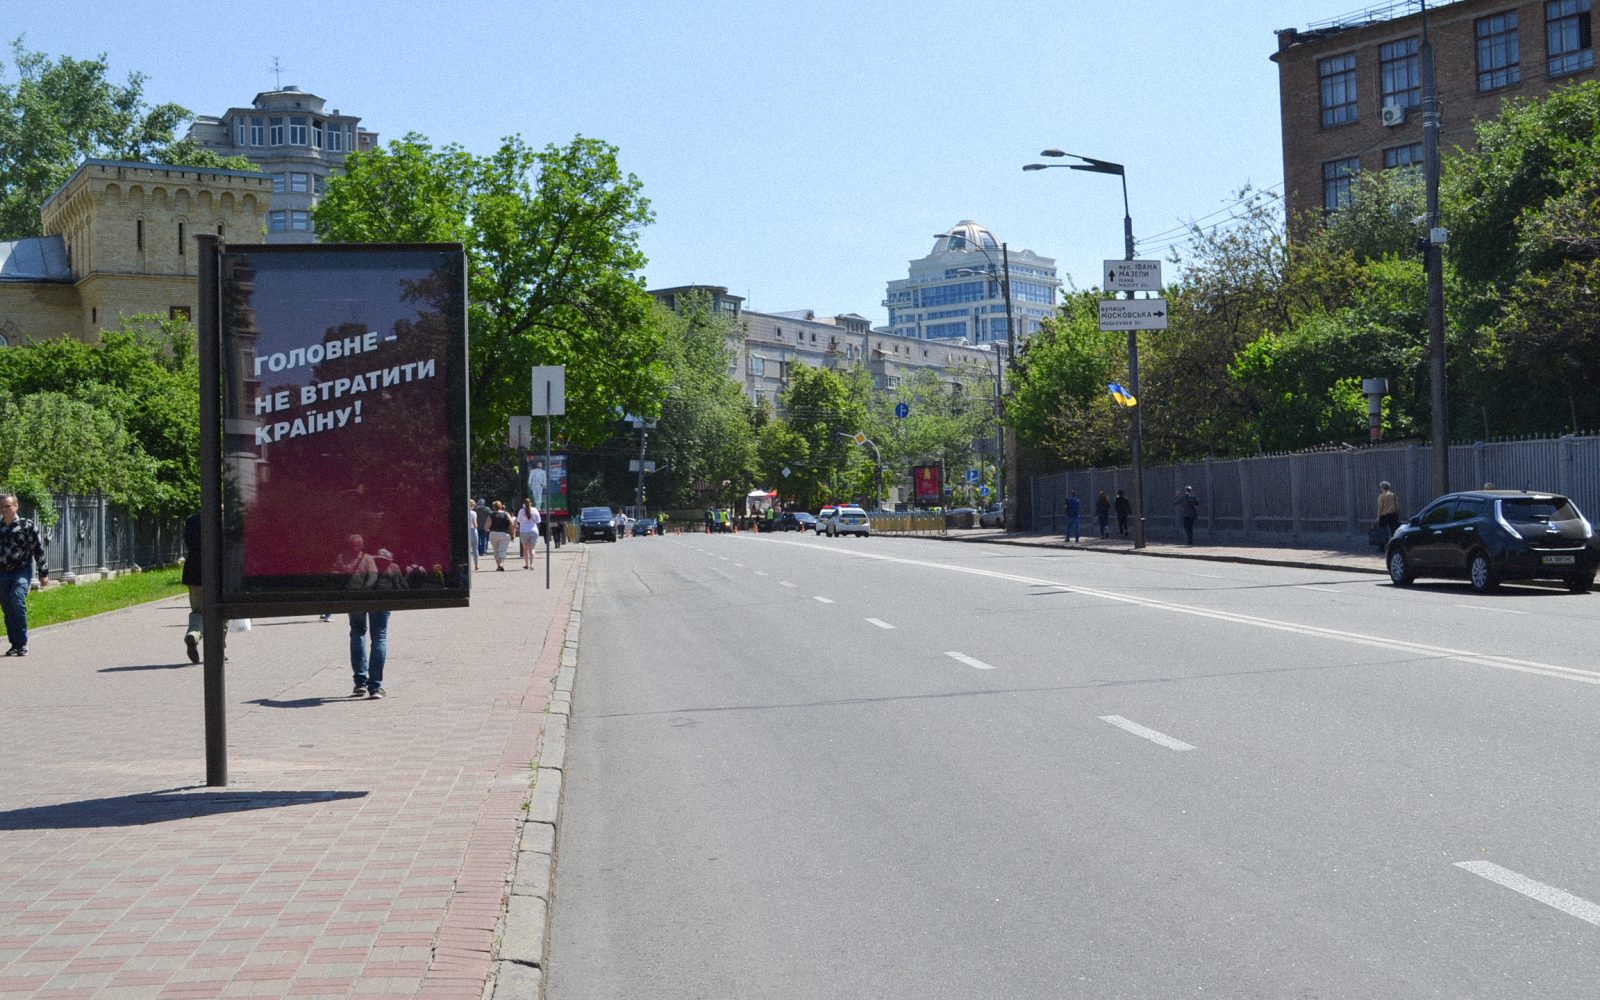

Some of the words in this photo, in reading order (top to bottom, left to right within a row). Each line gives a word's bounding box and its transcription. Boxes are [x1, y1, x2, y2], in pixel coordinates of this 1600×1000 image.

[1101, 311, 1152, 319] МОСКОВСЬКА
[254, 331, 378, 376] ГОЛОВНЕ
[255, 390, 290, 416] НЕ
[301, 358, 435, 406] ВТРАТИТИ
[255, 399, 362, 446] КРАЇНУ!
